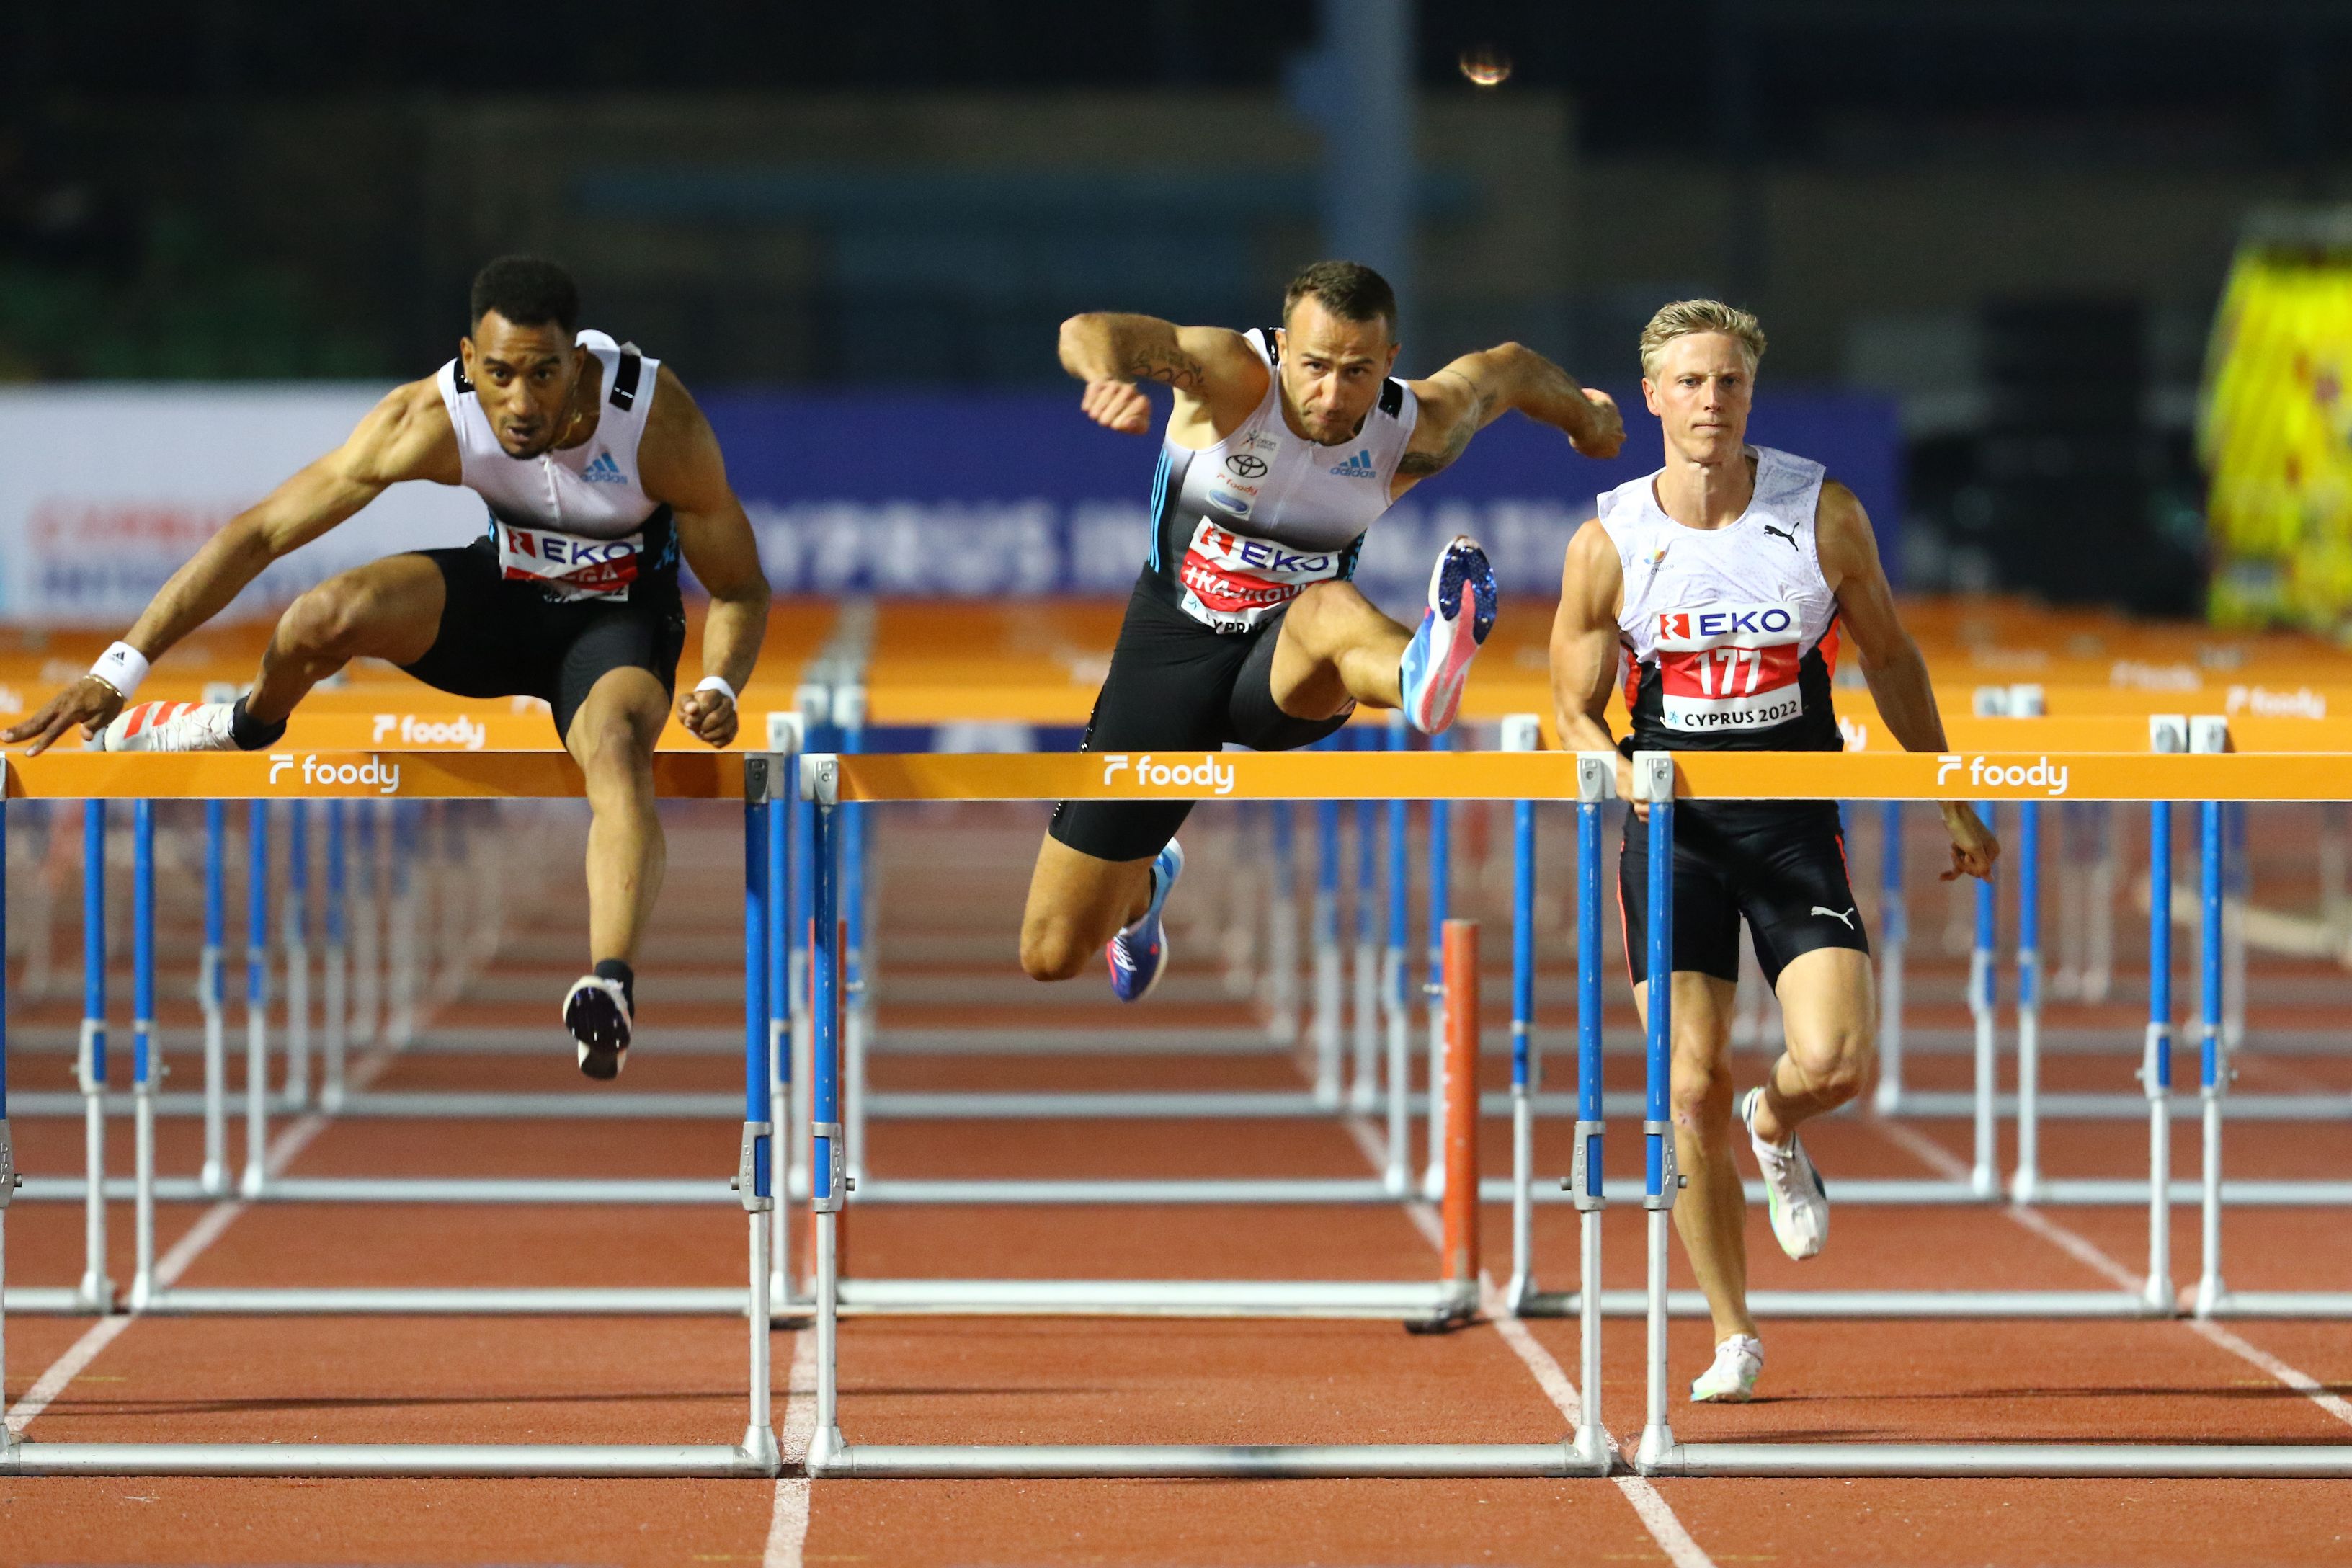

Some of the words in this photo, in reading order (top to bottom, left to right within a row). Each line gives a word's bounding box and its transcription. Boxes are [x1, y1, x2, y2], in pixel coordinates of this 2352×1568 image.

[579, 472, 628, 485] adidas
[1330, 466, 1376, 479] adidas
[543, 537, 636, 565] EKO
[1241, 541, 1329, 571] EKO
[1700, 609, 1791, 636] EKO
[1695, 648, 1762, 695] 177
[1685, 710, 1755, 727] CYPRUS
[1758, 700, 1798, 722] 2022
[400, 713, 486, 751] foody
[301, 754, 401, 794] foody
[1135, 754, 1234, 795] foody
[1969, 755, 2068, 796] foody
